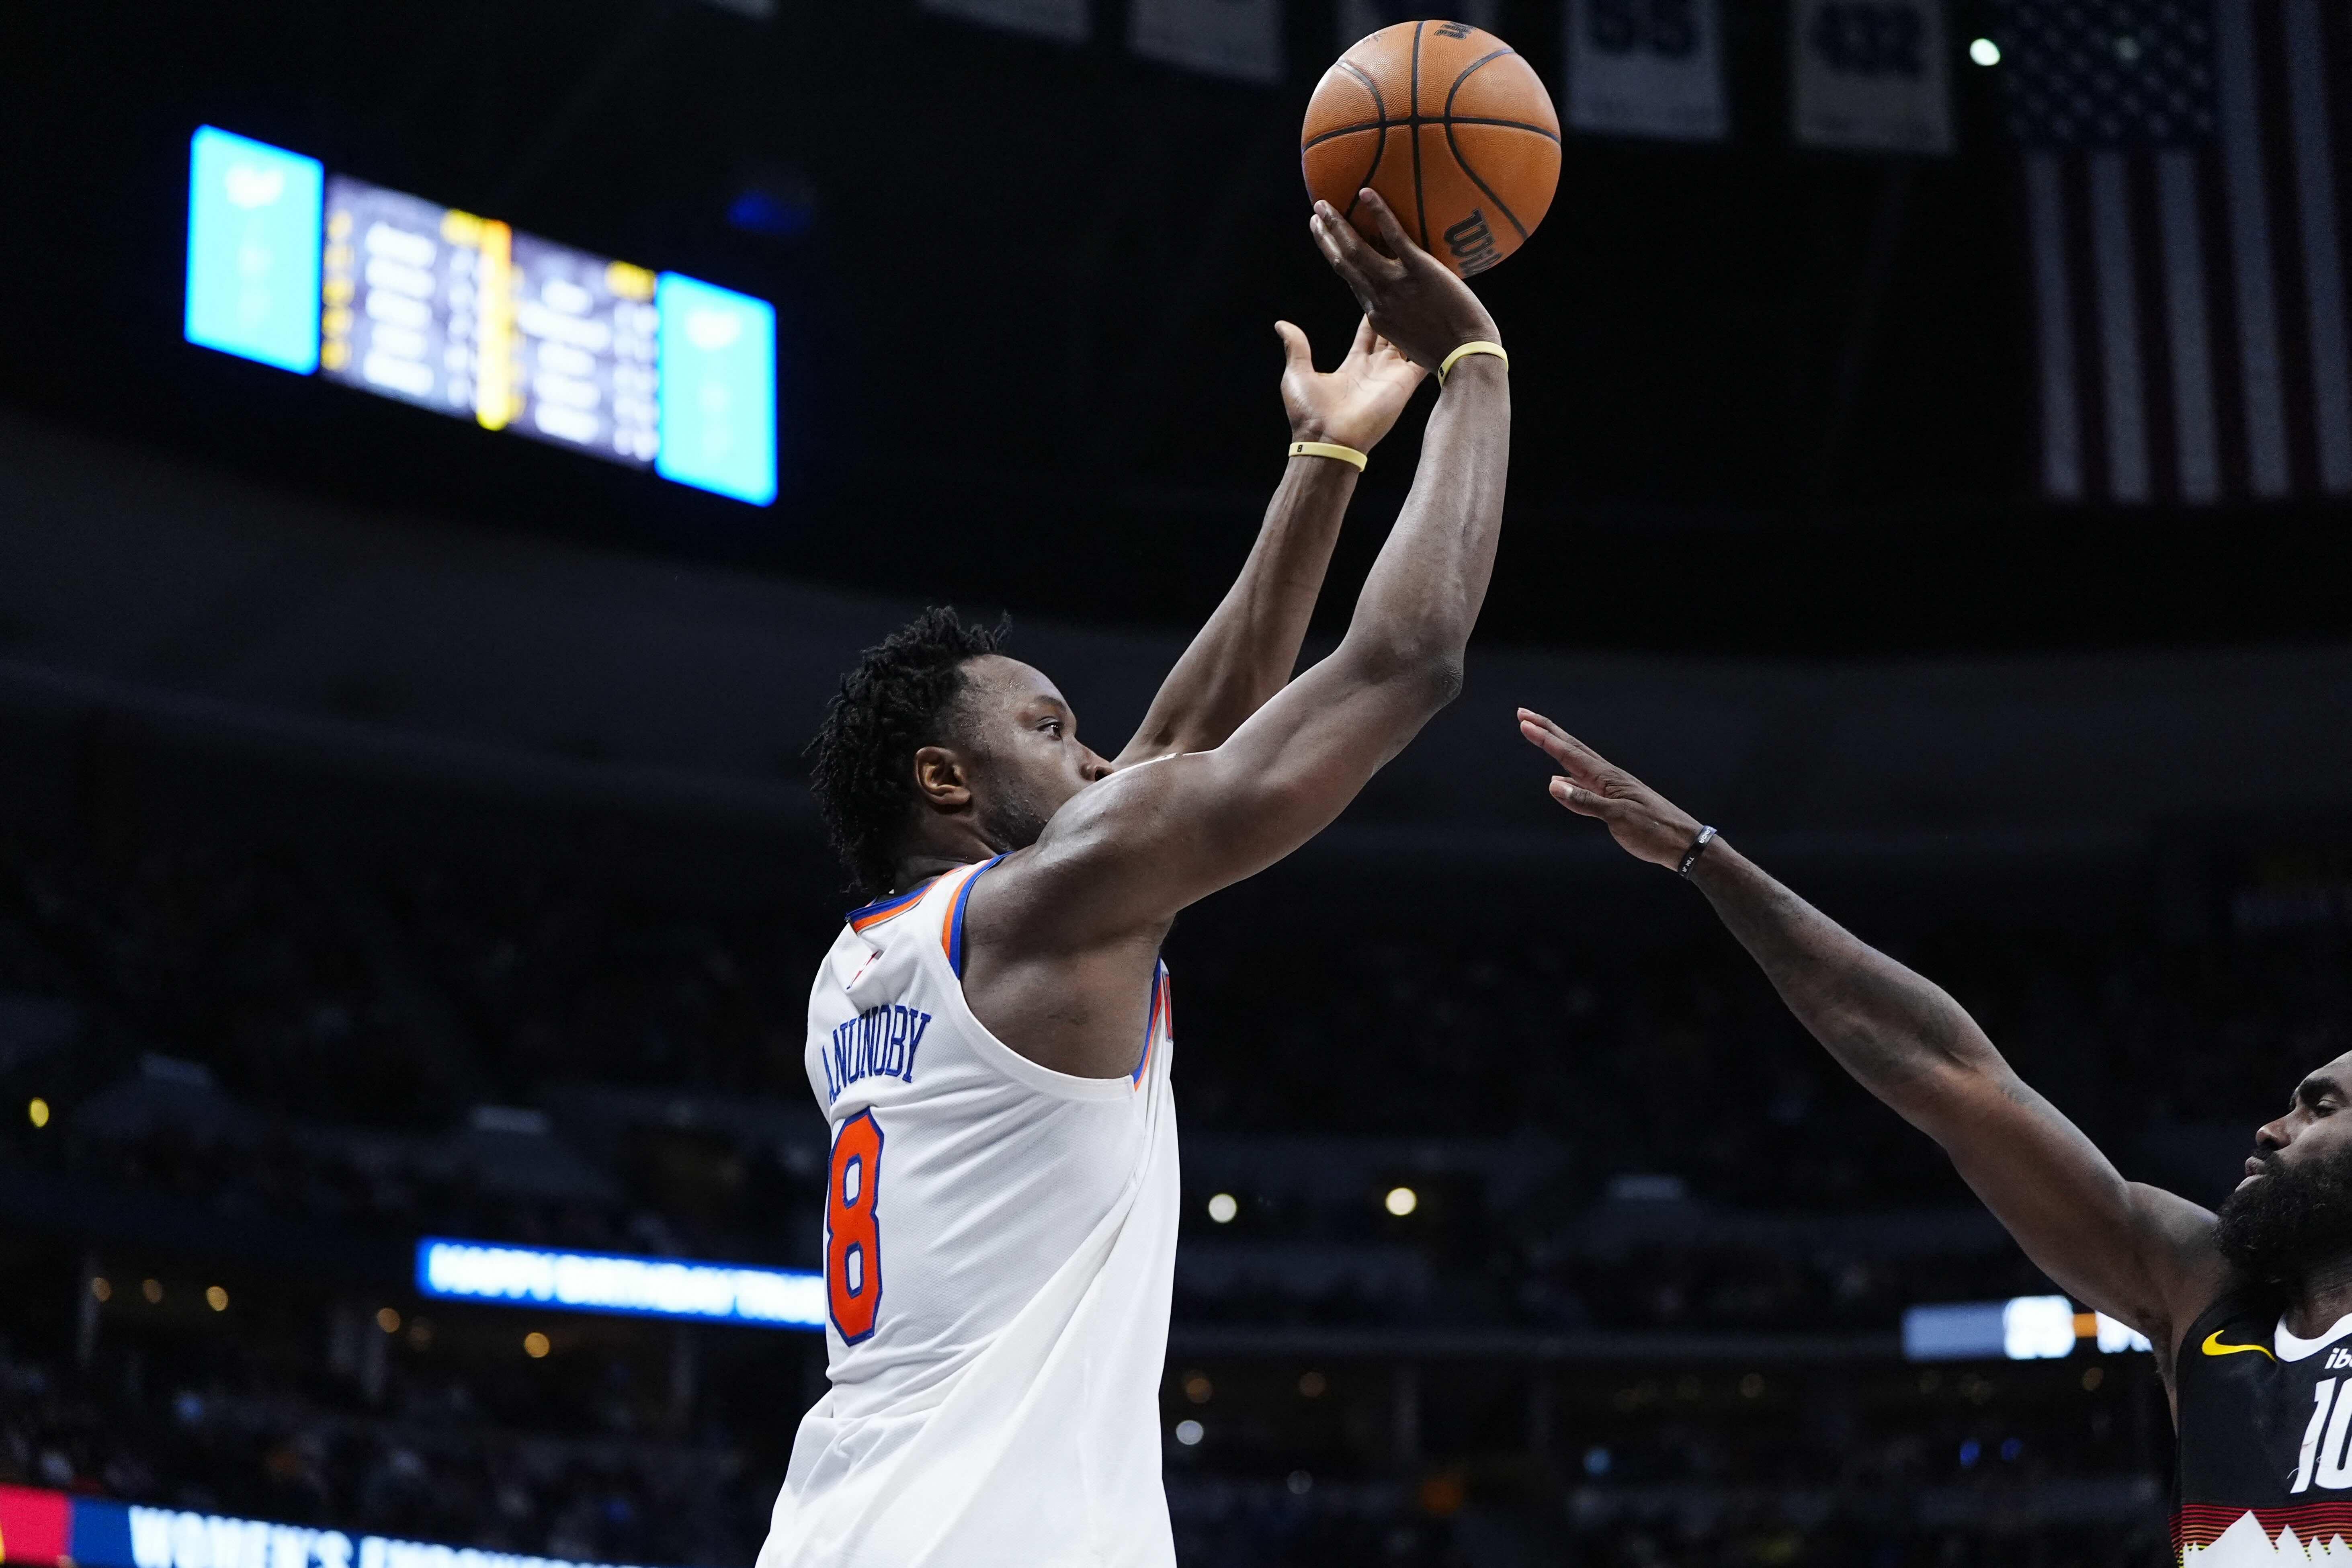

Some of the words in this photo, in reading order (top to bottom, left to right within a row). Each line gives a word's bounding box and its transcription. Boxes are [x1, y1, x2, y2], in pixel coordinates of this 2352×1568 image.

[822, 1004, 931, 1106] ANUNOBY
[827, 1106, 884, 1347] 8
[2325, 1347, 2352, 1369] ib
